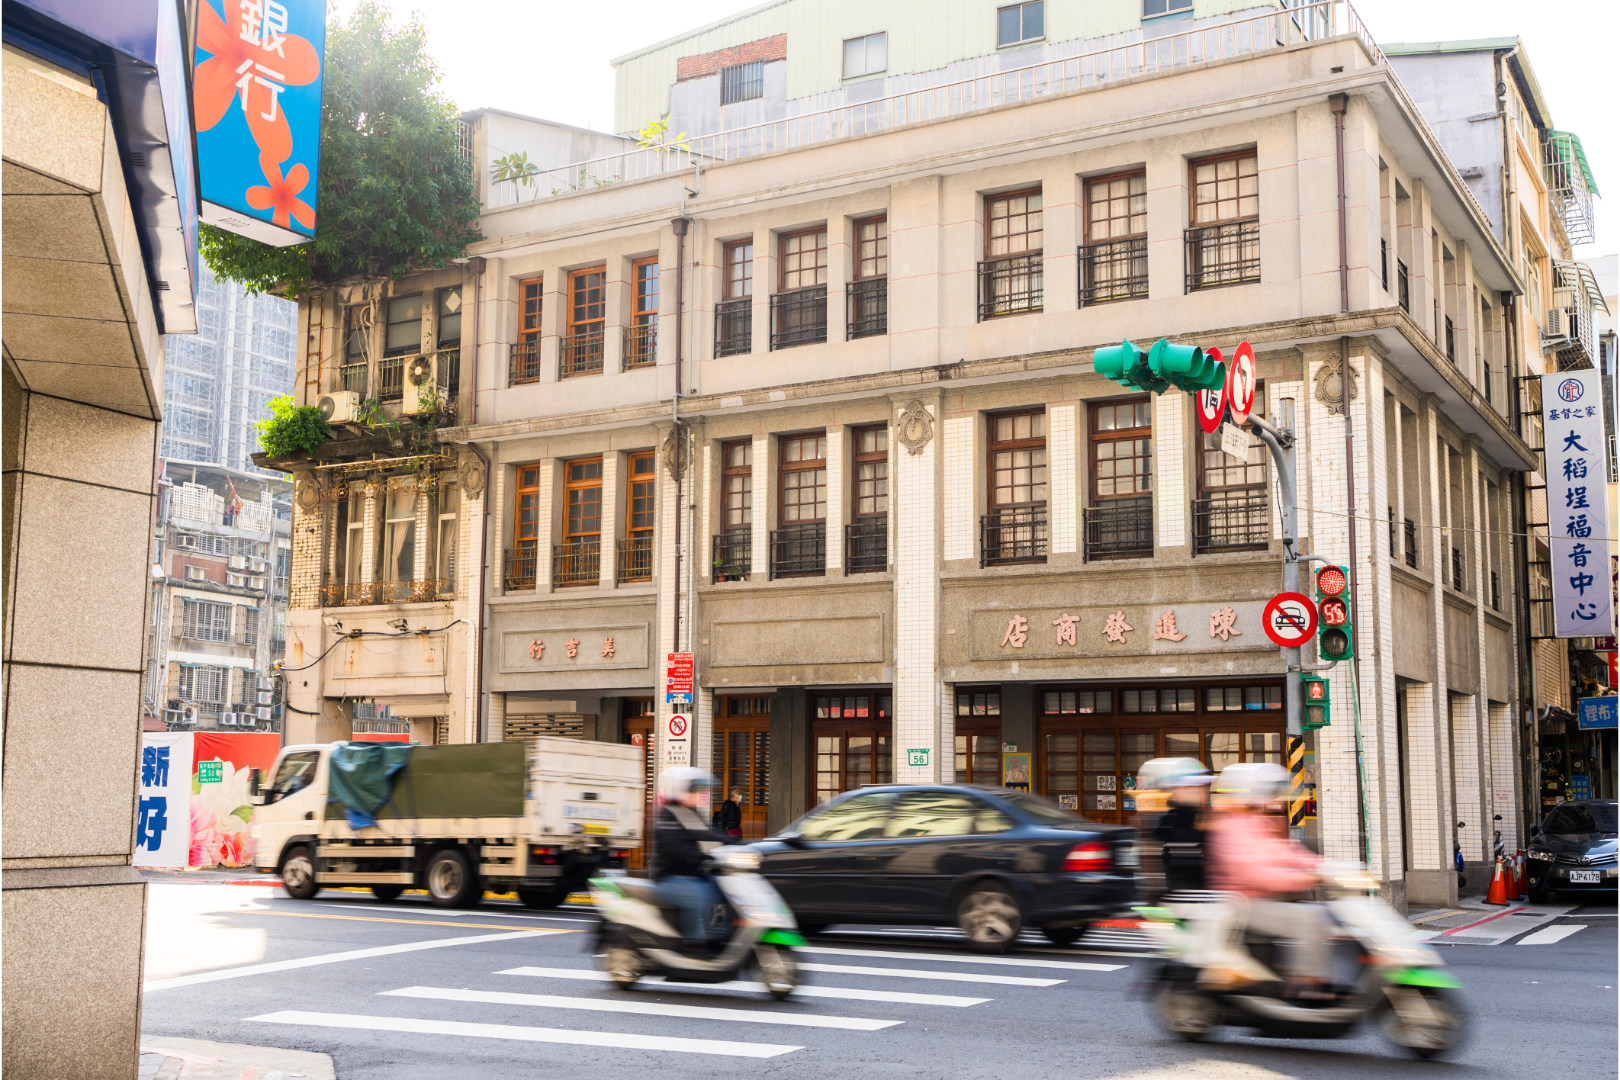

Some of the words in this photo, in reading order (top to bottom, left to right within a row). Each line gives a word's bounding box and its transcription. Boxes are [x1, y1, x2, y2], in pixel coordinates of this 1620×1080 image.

[235, 0, 288, 122] 銀行
[1548, 405, 1596, 421] 基督之家
[1562, 429, 1597, 621] 大稻埕福音中心
[913, 755, 925, 764] 56
